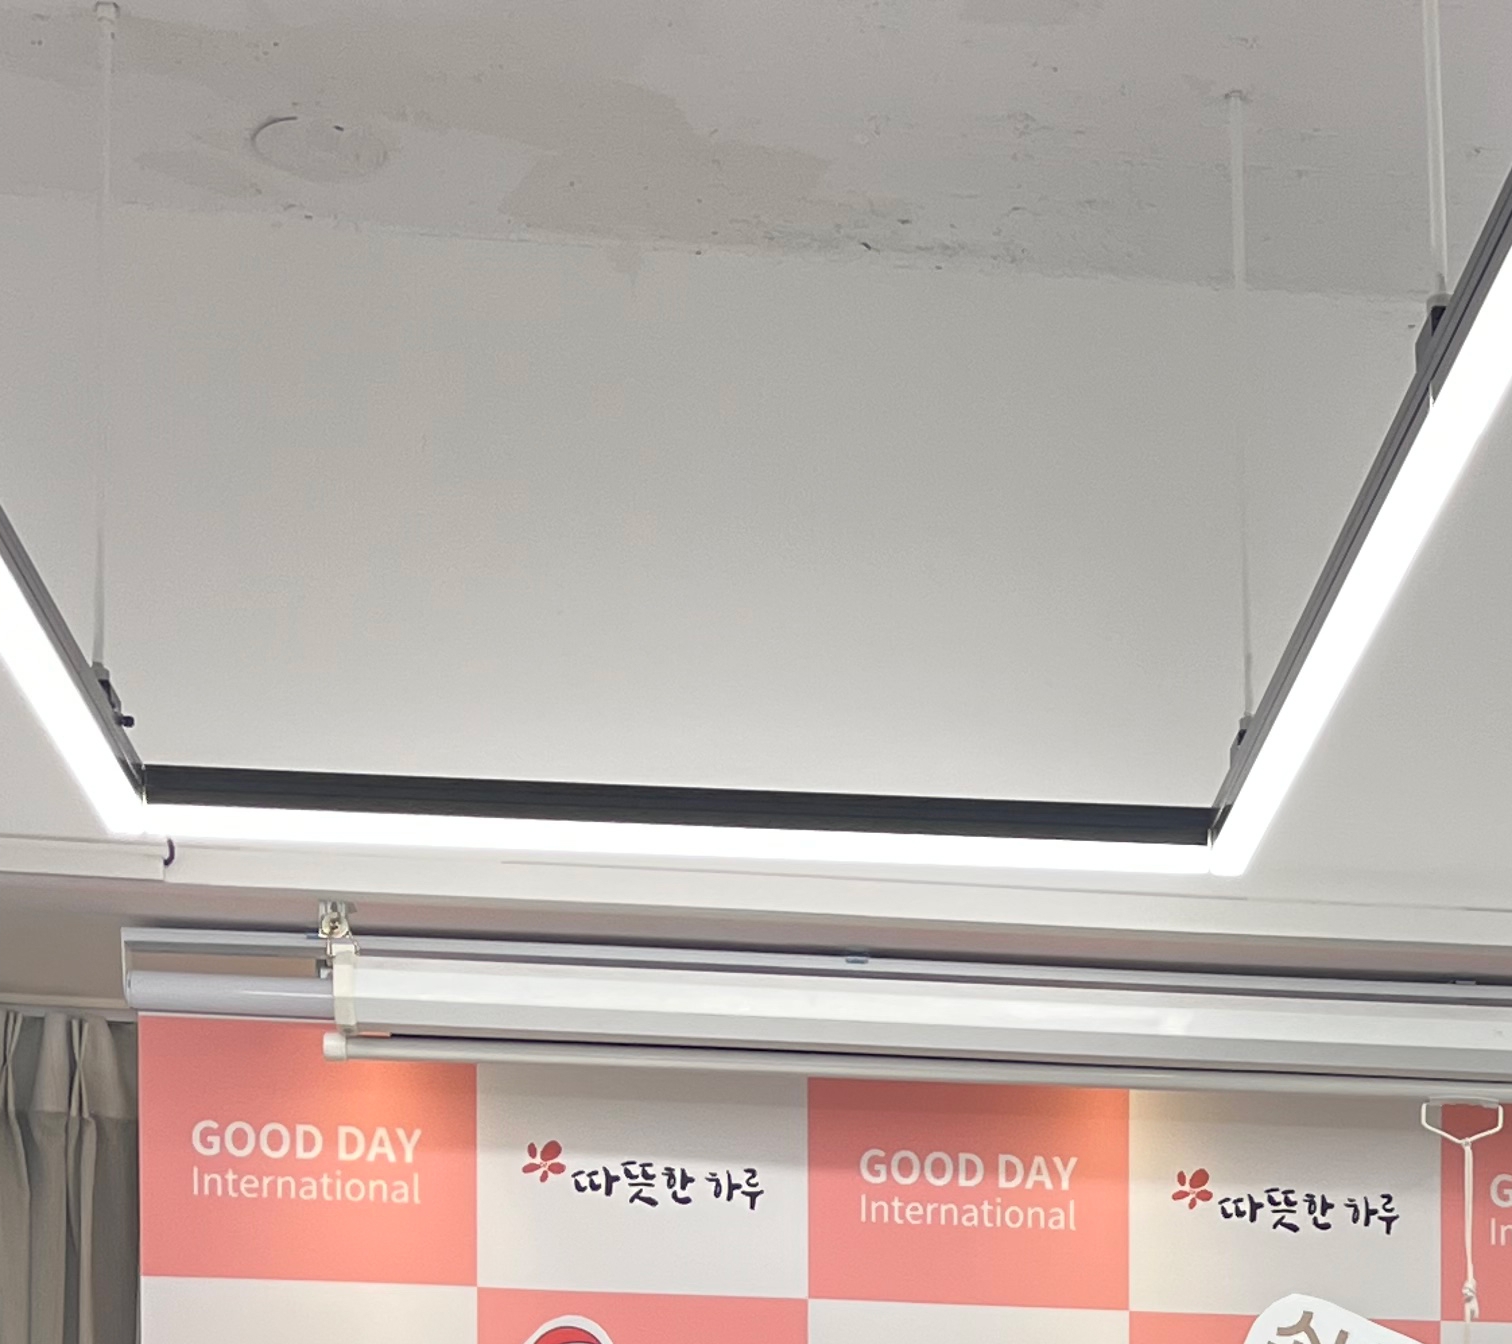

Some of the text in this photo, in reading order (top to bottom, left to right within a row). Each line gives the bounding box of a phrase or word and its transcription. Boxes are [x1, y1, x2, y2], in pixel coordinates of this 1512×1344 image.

[192, 1119, 422, 1164] GOOD DAY
[192, 1167, 421, 1205] International
[572, 1160, 765, 1210] 따뜻한 하루
[859, 1150, 1078, 1190] GOOD DAY
[859, 1194, 1077, 1230] International
[1218, 1188, 1400, 1234] 따뜻한 하루
